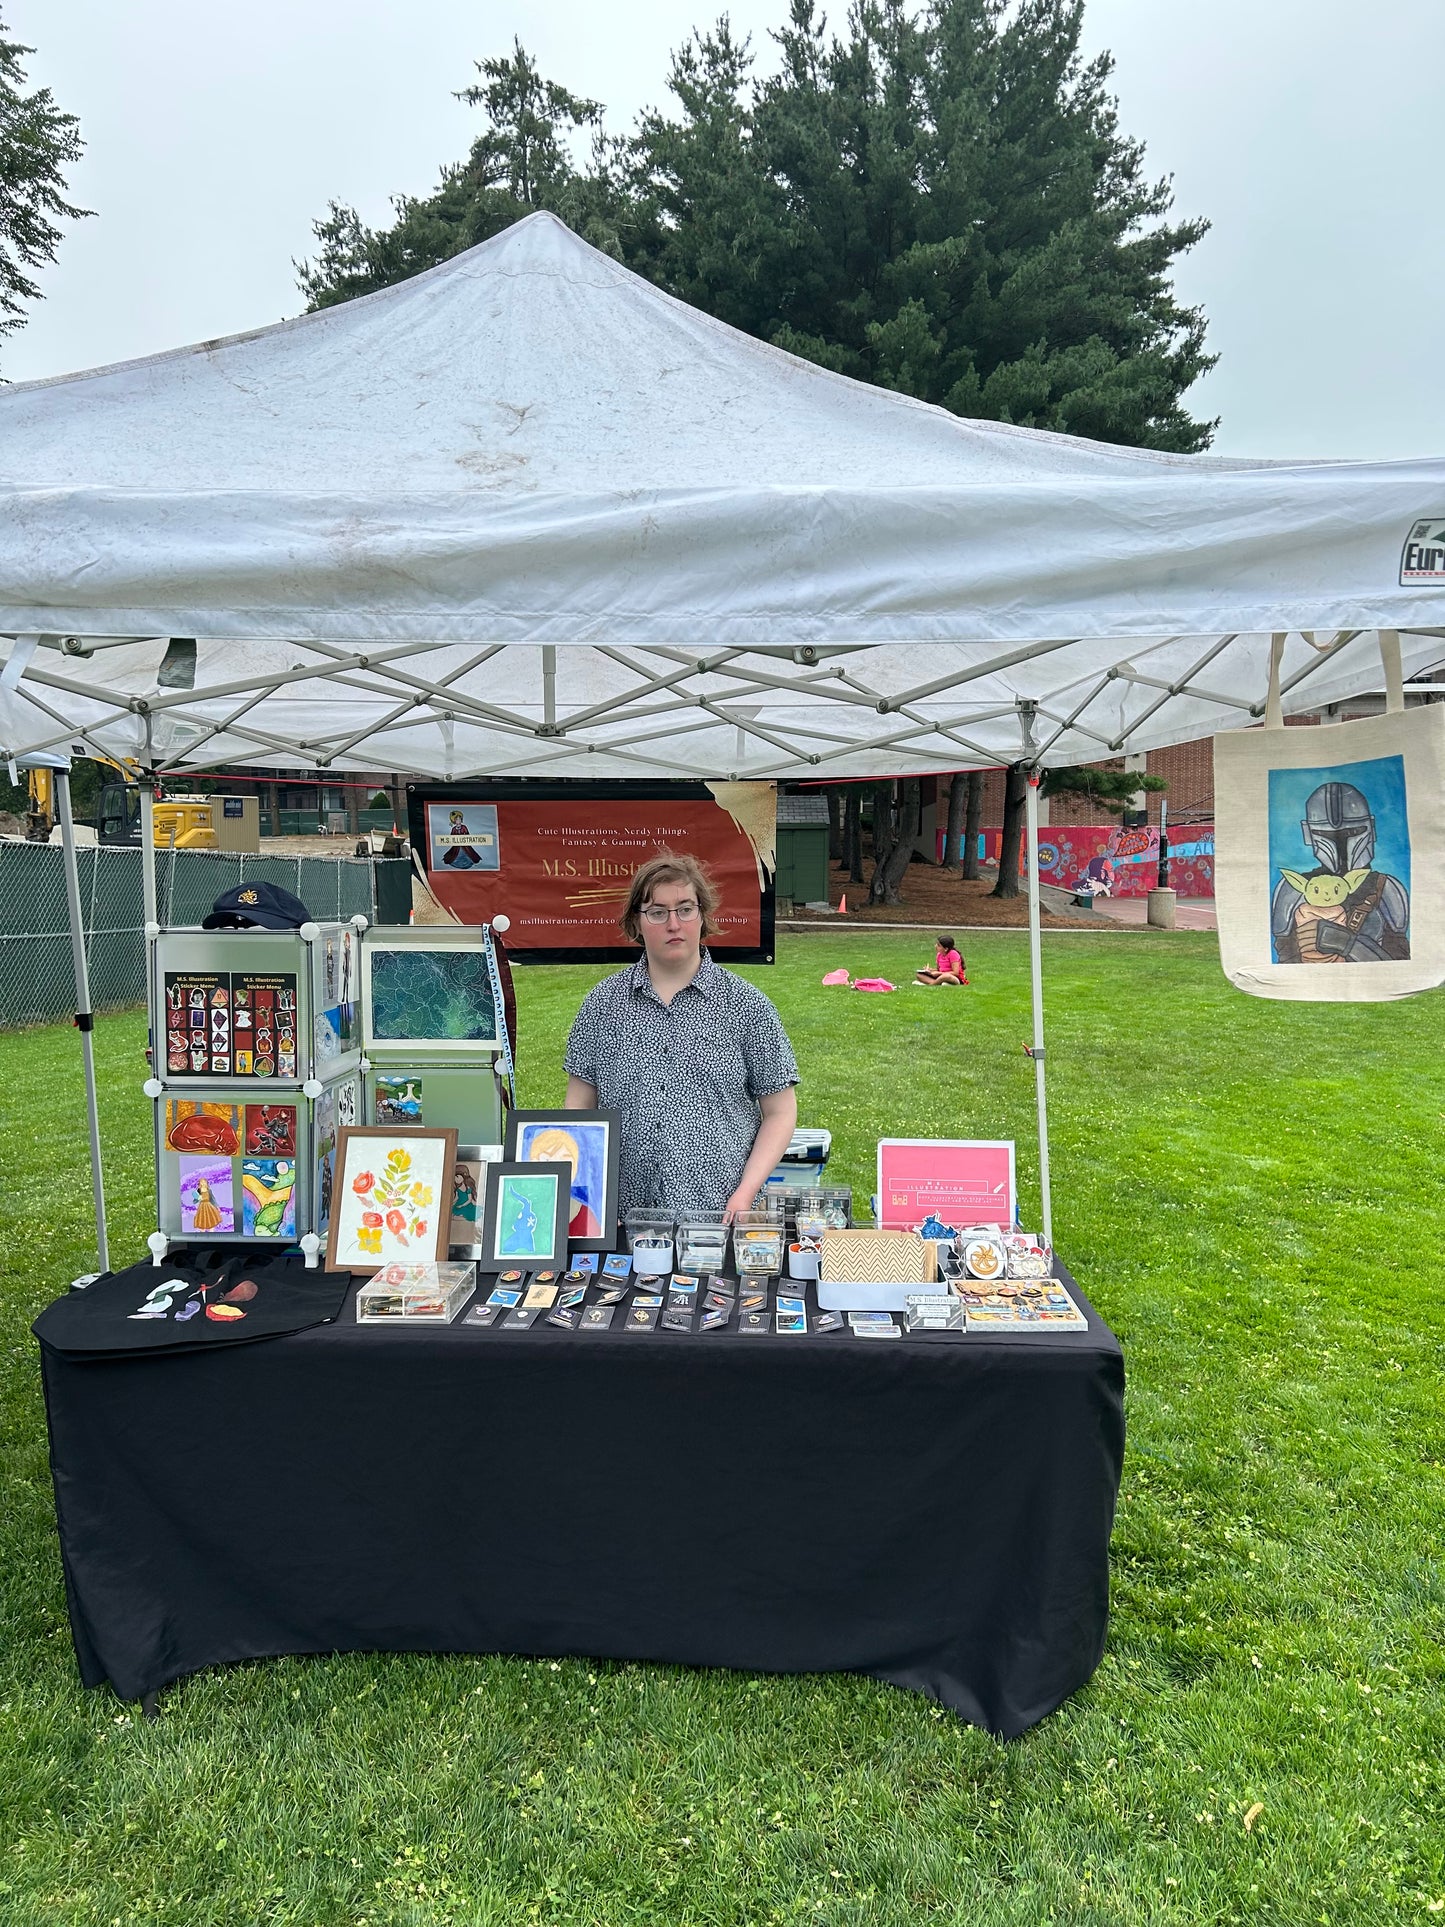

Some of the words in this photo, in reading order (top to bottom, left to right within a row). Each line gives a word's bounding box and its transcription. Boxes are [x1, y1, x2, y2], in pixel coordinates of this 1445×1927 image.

[1404, 543, 1445, 571] Eur
[537, 827, 559, 835] Cute
[624, 827, 651, 837] Nerdy
[452, 836, 487, 844] ILLUSTRATION
[562, 838, 597, 847] Fantasy
[601, 838, 607, 846] &
[611, 838, 647, 847] Gaming
[651, 838, 666, 846] Art
[542, 858, 581, 877] M.S.
[588, 858, 645, 877] Illustr
[712, 916, 748, 924] onsshop
